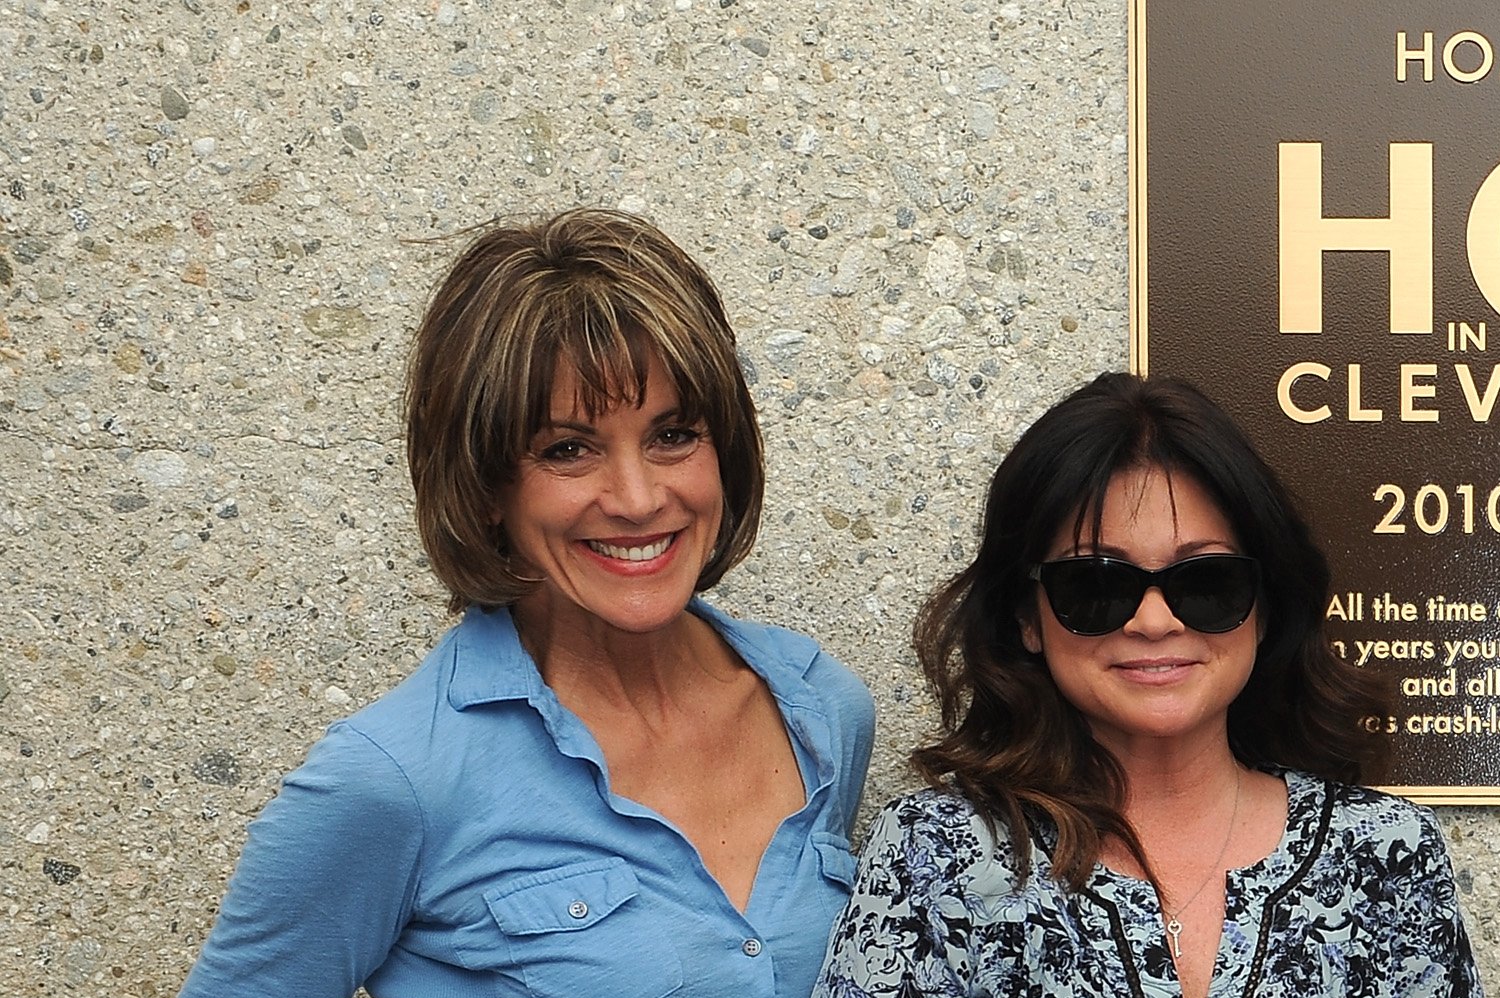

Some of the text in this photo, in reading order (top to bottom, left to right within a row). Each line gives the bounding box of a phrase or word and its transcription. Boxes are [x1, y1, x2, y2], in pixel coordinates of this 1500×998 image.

[1447, 320, 1487, 352] IN
[1373, 593, 1418, 621] the
[1428, 595, 1486, 621] time
[1356, 640, 1435, 667] years
[1402, 668, 1456, 697] and
[1467, 668, 1500, 697] all
[1357, 714, 1397, 734] as
